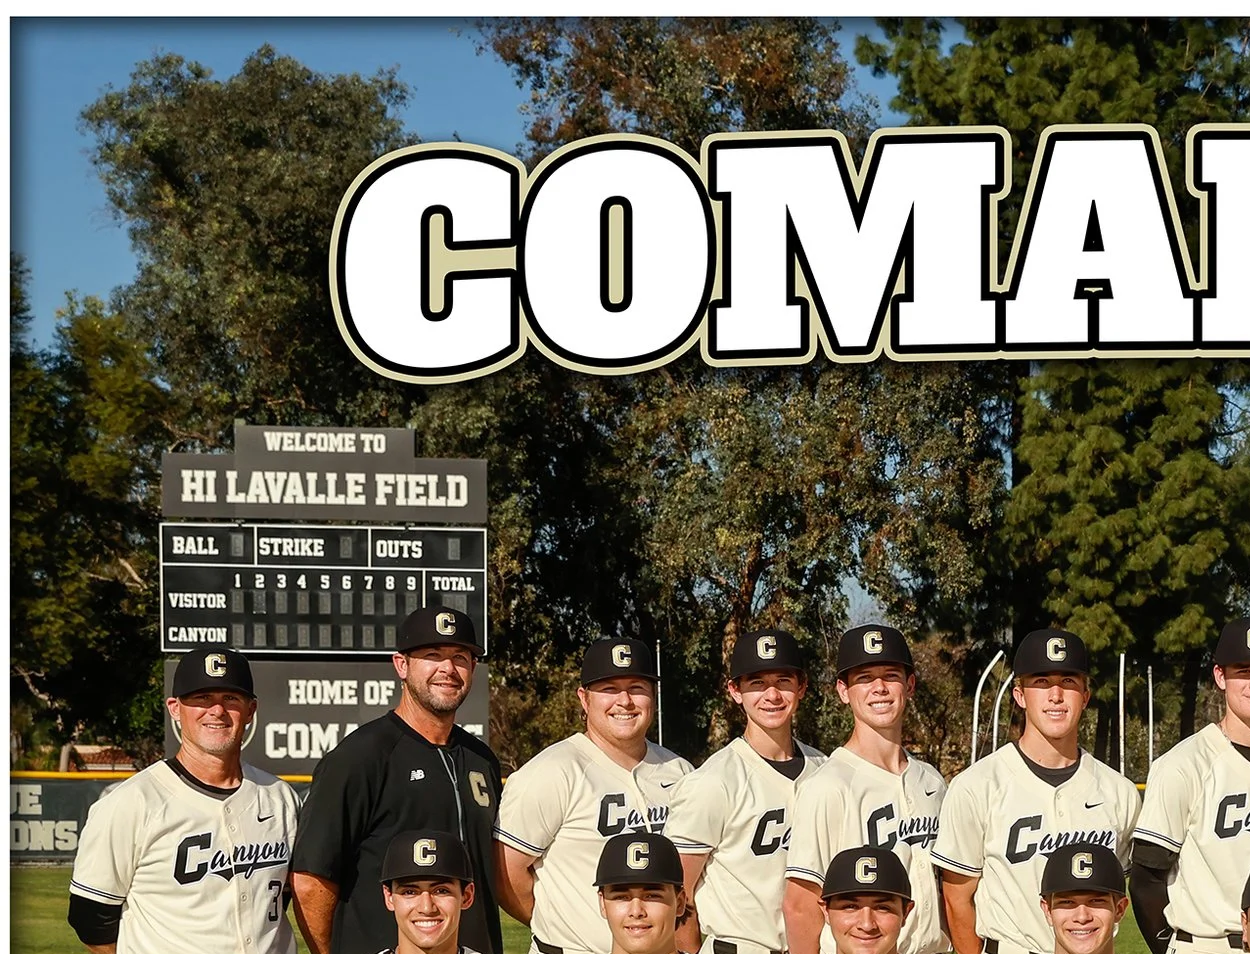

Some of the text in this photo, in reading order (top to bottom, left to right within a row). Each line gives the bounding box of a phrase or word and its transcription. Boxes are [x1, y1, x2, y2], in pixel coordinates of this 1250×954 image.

[264, 432, 386, 453] WELCOME TO
[181, 470, 468, 507] HI LAVALLE FIELD
[172, 536, 218, 555] BALL
[259, 538, 324, 558] STRIKE
[376, 540, 422, 559] OUTS
[234, 574, 475, 591] 1 2 3 4 5 6 7 8 9 TOTAL
[169, 593, 226, 609] VISITOR
[169, 627, 226, 643] CANYON
[435, 613, 455, 636] C
[756, 636, 776, 659] C
[863, 631, 883, 654] C
[1046, 638, 1066, 661] C
[205, 654, 226, 677] C
[611, 645, 631, 667] C
[289, 680, 395, 705] HOME OF
[469, 771, 490, 807] C
[597, 793, 669, 837] Cany
[174, 832, 287, 885] Canyon
[413, 839, 437, 866] C
[626, 842, 650, 870] C
[855, 857, 878, 883] C
[1071, 853, 1093, 879] C
